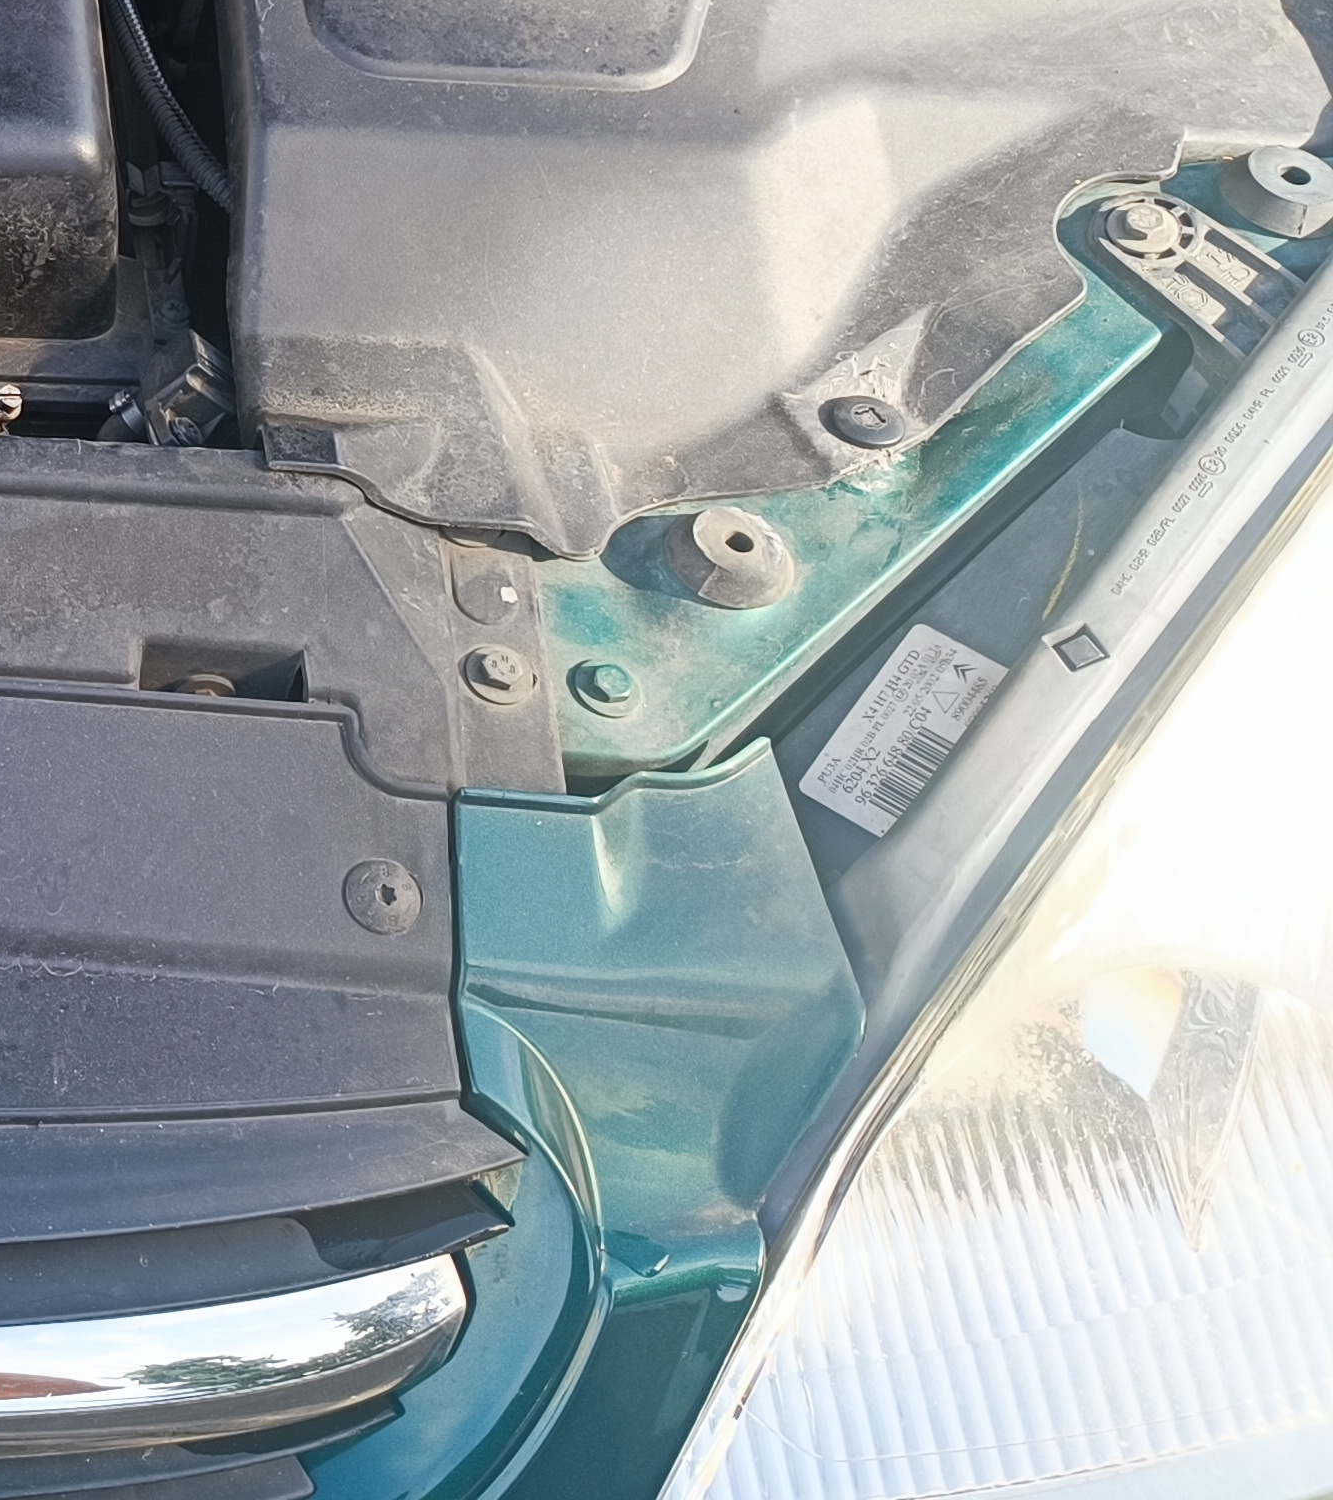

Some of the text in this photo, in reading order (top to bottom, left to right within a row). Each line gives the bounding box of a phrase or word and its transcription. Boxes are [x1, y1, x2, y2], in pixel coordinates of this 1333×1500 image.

[817, 649, 920, 784] PU3A X4 H7 H4 GTD
[903, 673, 940, 718] 22/05/2002
[951, 676, 987, 722] 89004485
[842, 746, 881, 794] 6204.X2
[854, 788, 873, 806] 96
[865, 766, 888, 791] 326
[882, 745, 903, 768] 648
